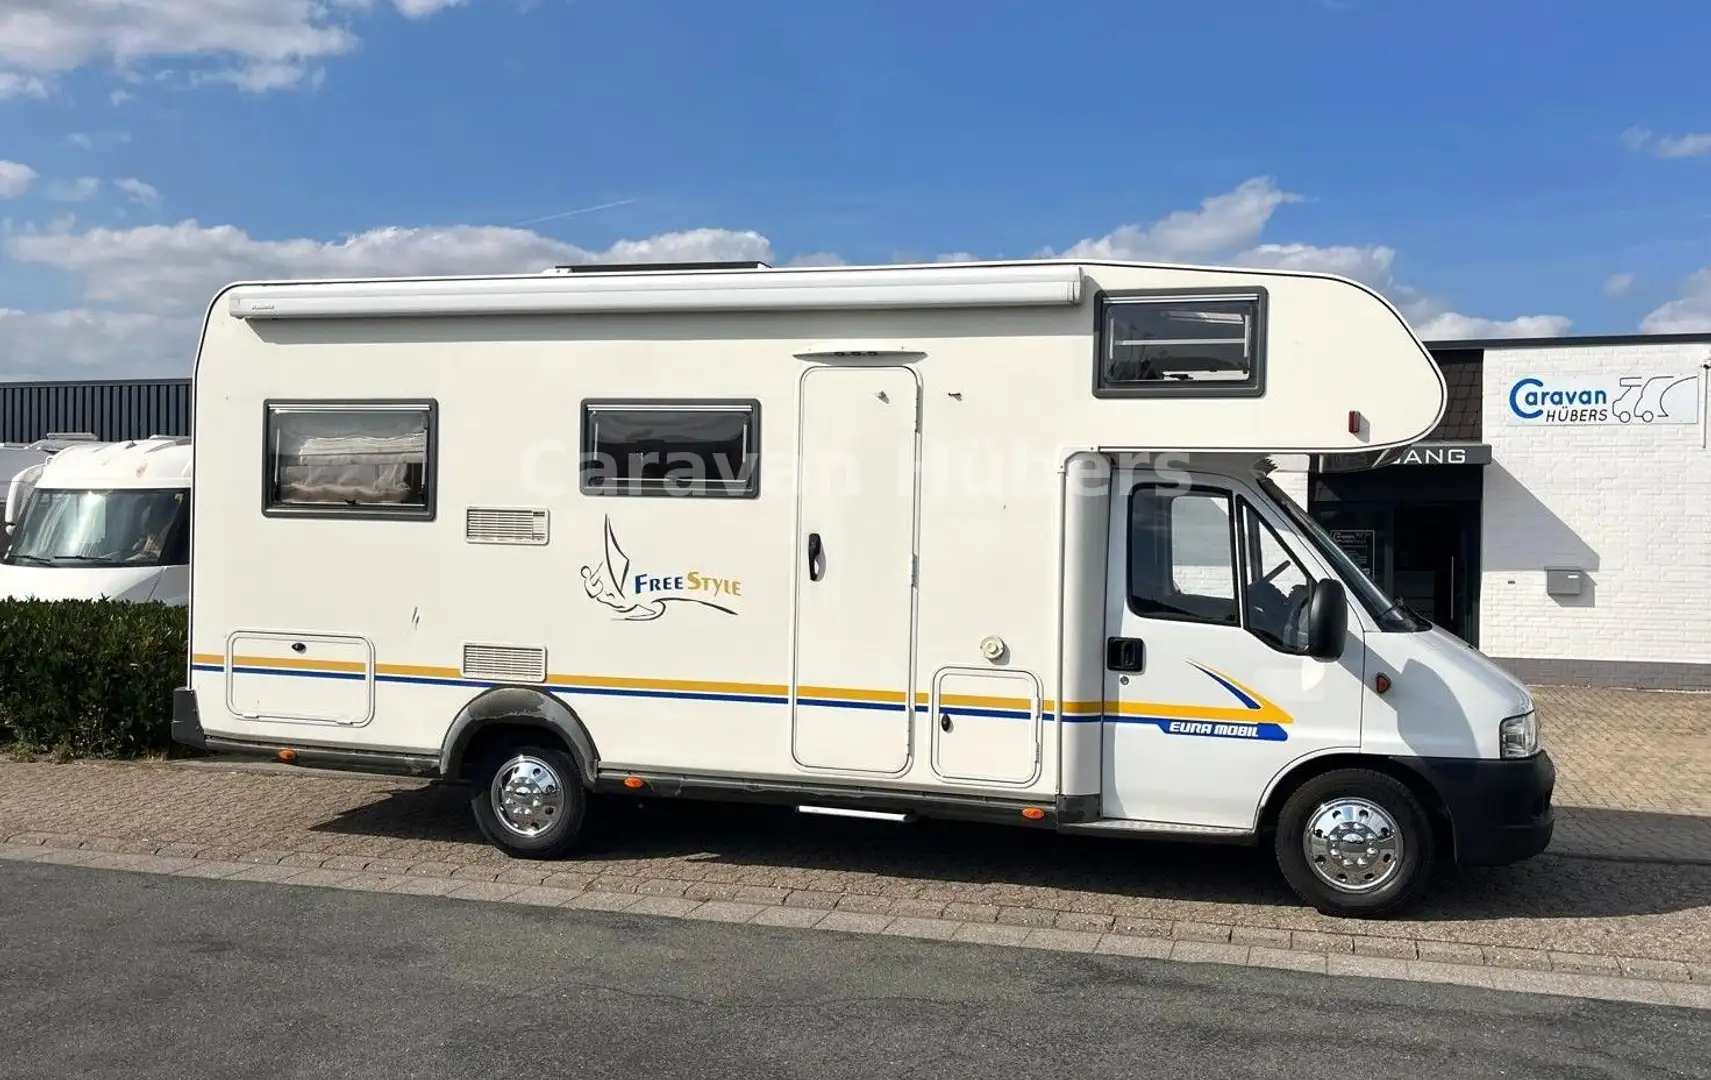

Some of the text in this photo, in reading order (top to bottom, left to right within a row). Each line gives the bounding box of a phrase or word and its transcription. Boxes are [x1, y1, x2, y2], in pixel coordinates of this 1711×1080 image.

[1509, 378, 1607, 418] Caravan
[1546, 406, 1608, 422] HÜBERS
[1169, 721, 1259, 737] EURA MOBIL
